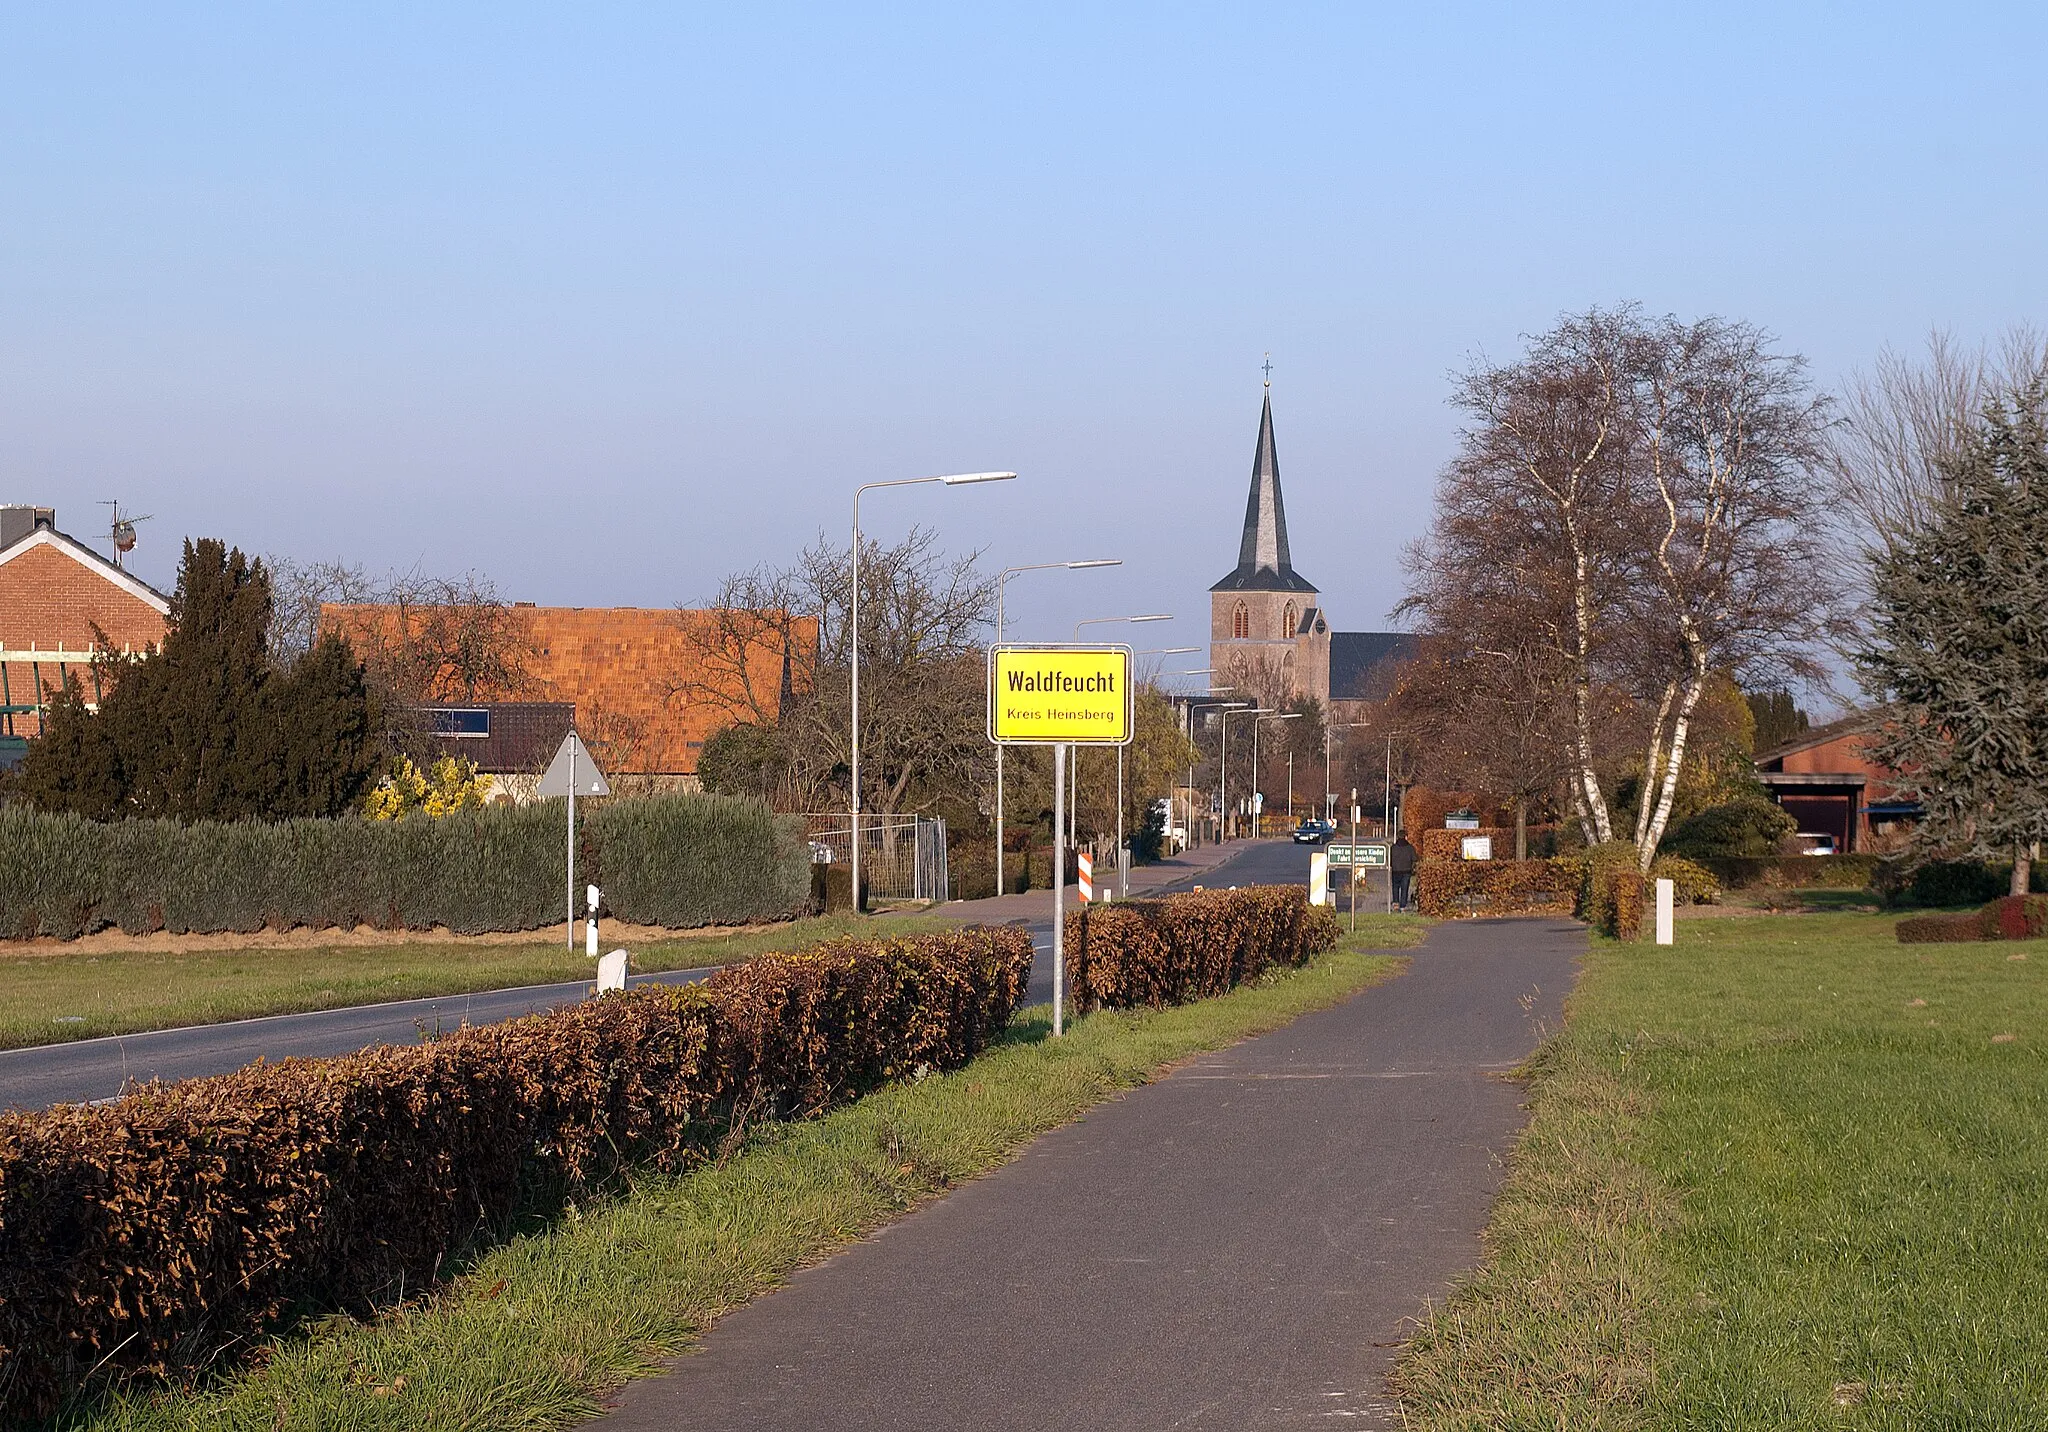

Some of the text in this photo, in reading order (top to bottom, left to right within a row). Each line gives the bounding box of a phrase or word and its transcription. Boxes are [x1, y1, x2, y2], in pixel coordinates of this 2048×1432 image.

[1008, 670, 1115, 692] Waldfeucht
[1007, 708, 1114, 723] Kreis Heinsberg
